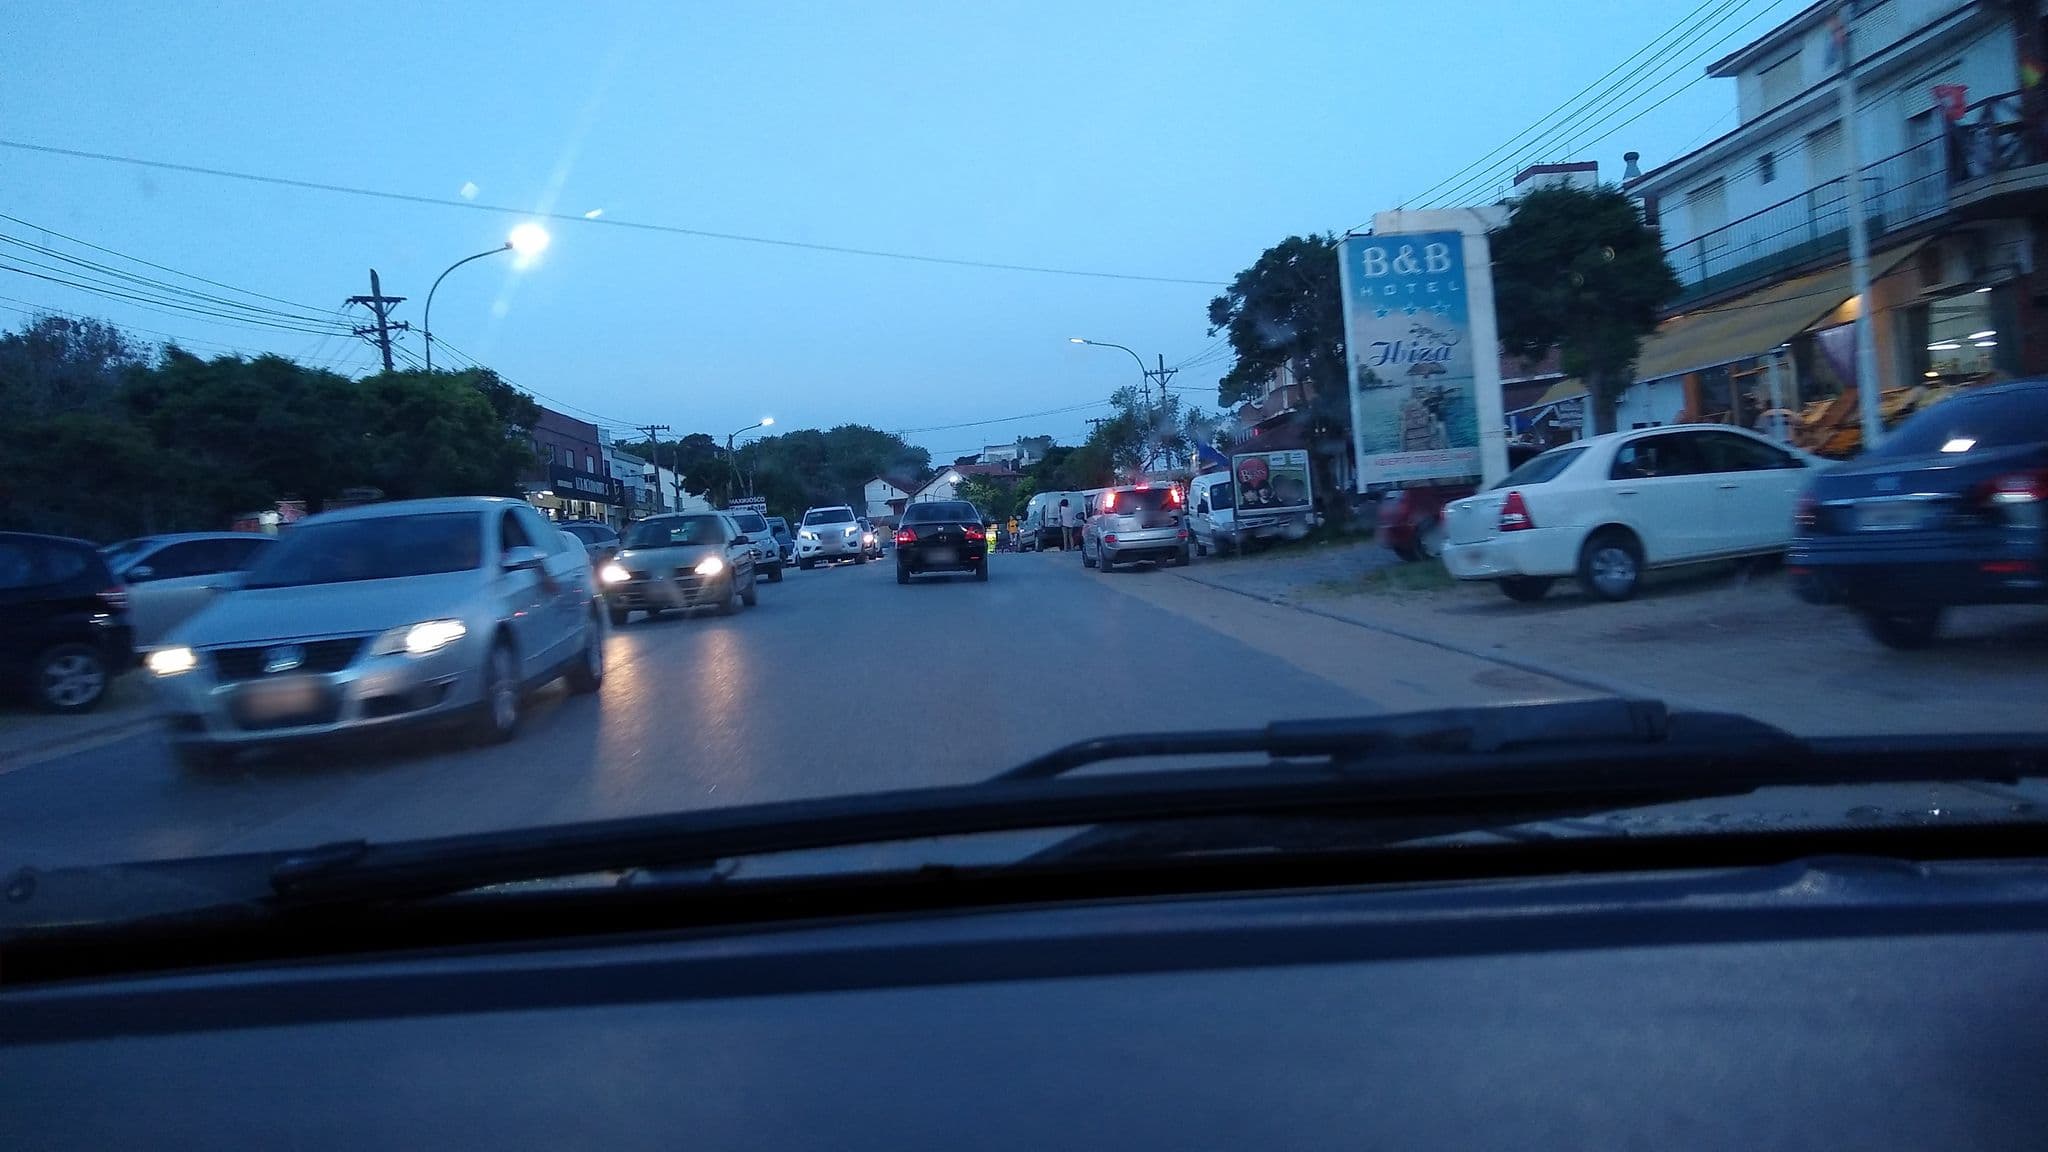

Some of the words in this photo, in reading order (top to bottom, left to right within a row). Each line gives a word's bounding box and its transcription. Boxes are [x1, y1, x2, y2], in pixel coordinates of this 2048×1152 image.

[1362, 243, 1452, 278] B&B
[1361, 281, 1460, 297] HOTEL
[1370, 339, 1454, 367] Ibiza
